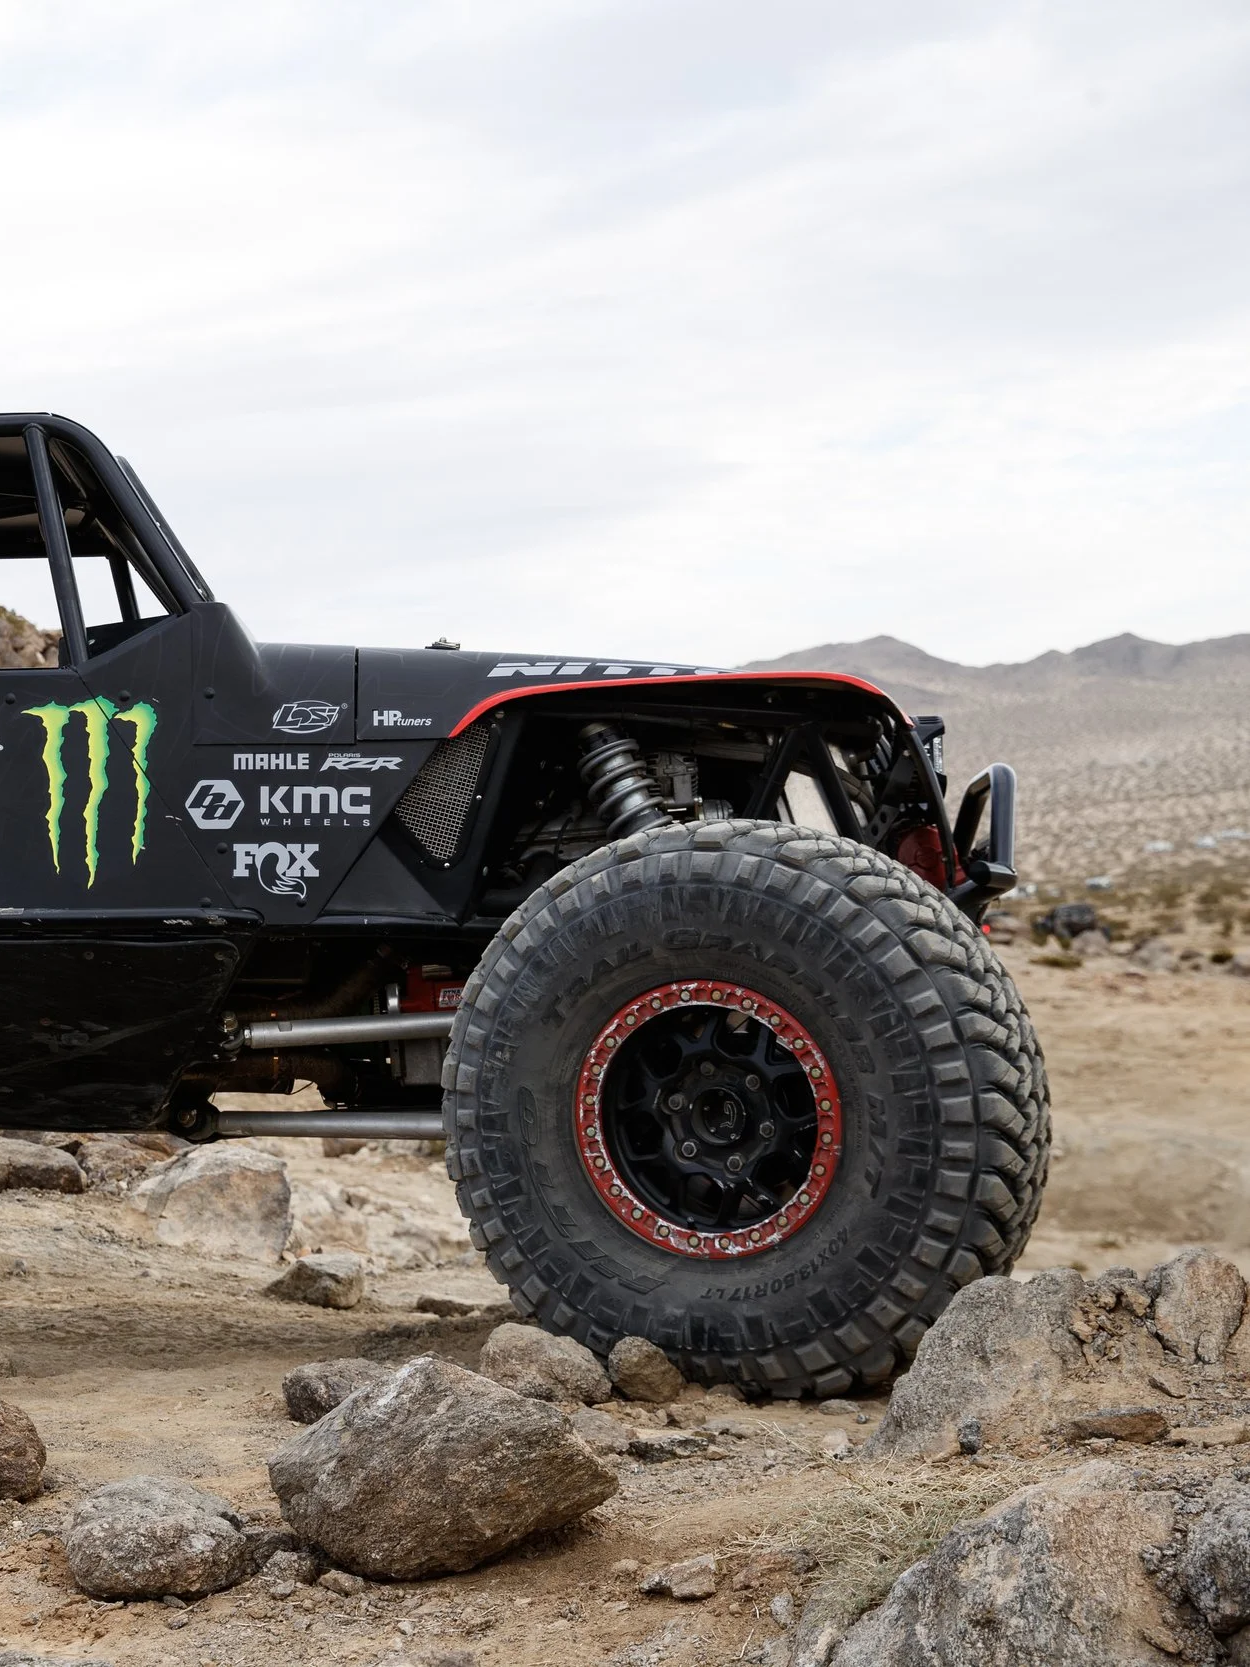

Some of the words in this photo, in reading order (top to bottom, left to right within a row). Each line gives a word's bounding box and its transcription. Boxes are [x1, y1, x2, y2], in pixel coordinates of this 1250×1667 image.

[233, 753, 310, 771] MAHLE
[319, 757, 404, 772] RZR
[260, 818, 371, 827] WHEELS
[233, 842, 319, 880] FOX
